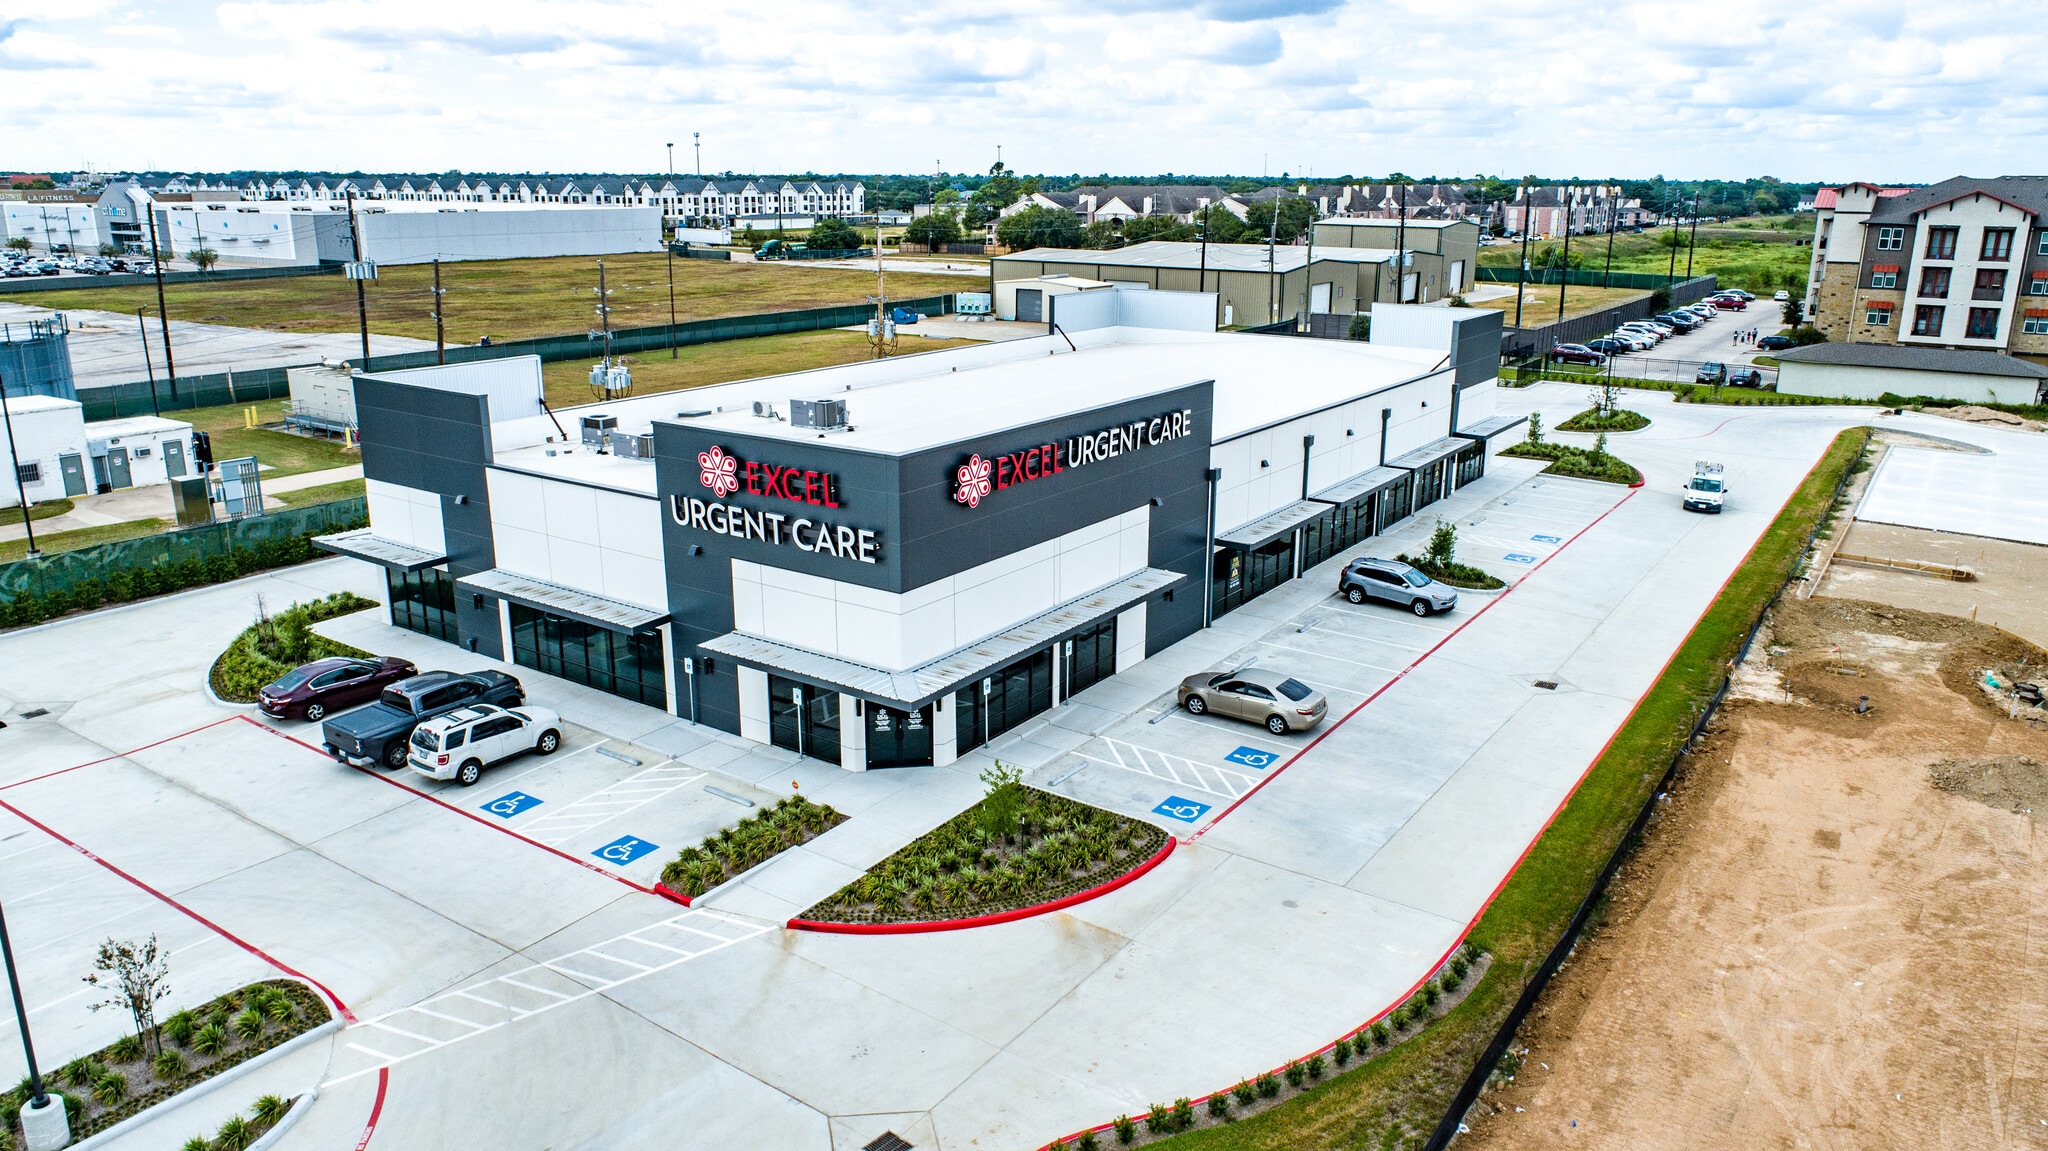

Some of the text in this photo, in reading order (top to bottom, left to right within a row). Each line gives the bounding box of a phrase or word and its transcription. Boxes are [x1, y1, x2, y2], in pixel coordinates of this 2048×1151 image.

[745, 461, 840, 508] EXCEL
[997, 408, 1192, 491] EXCEL URGENT CARE
[670, 494, 876, 564] URGENT CARE
